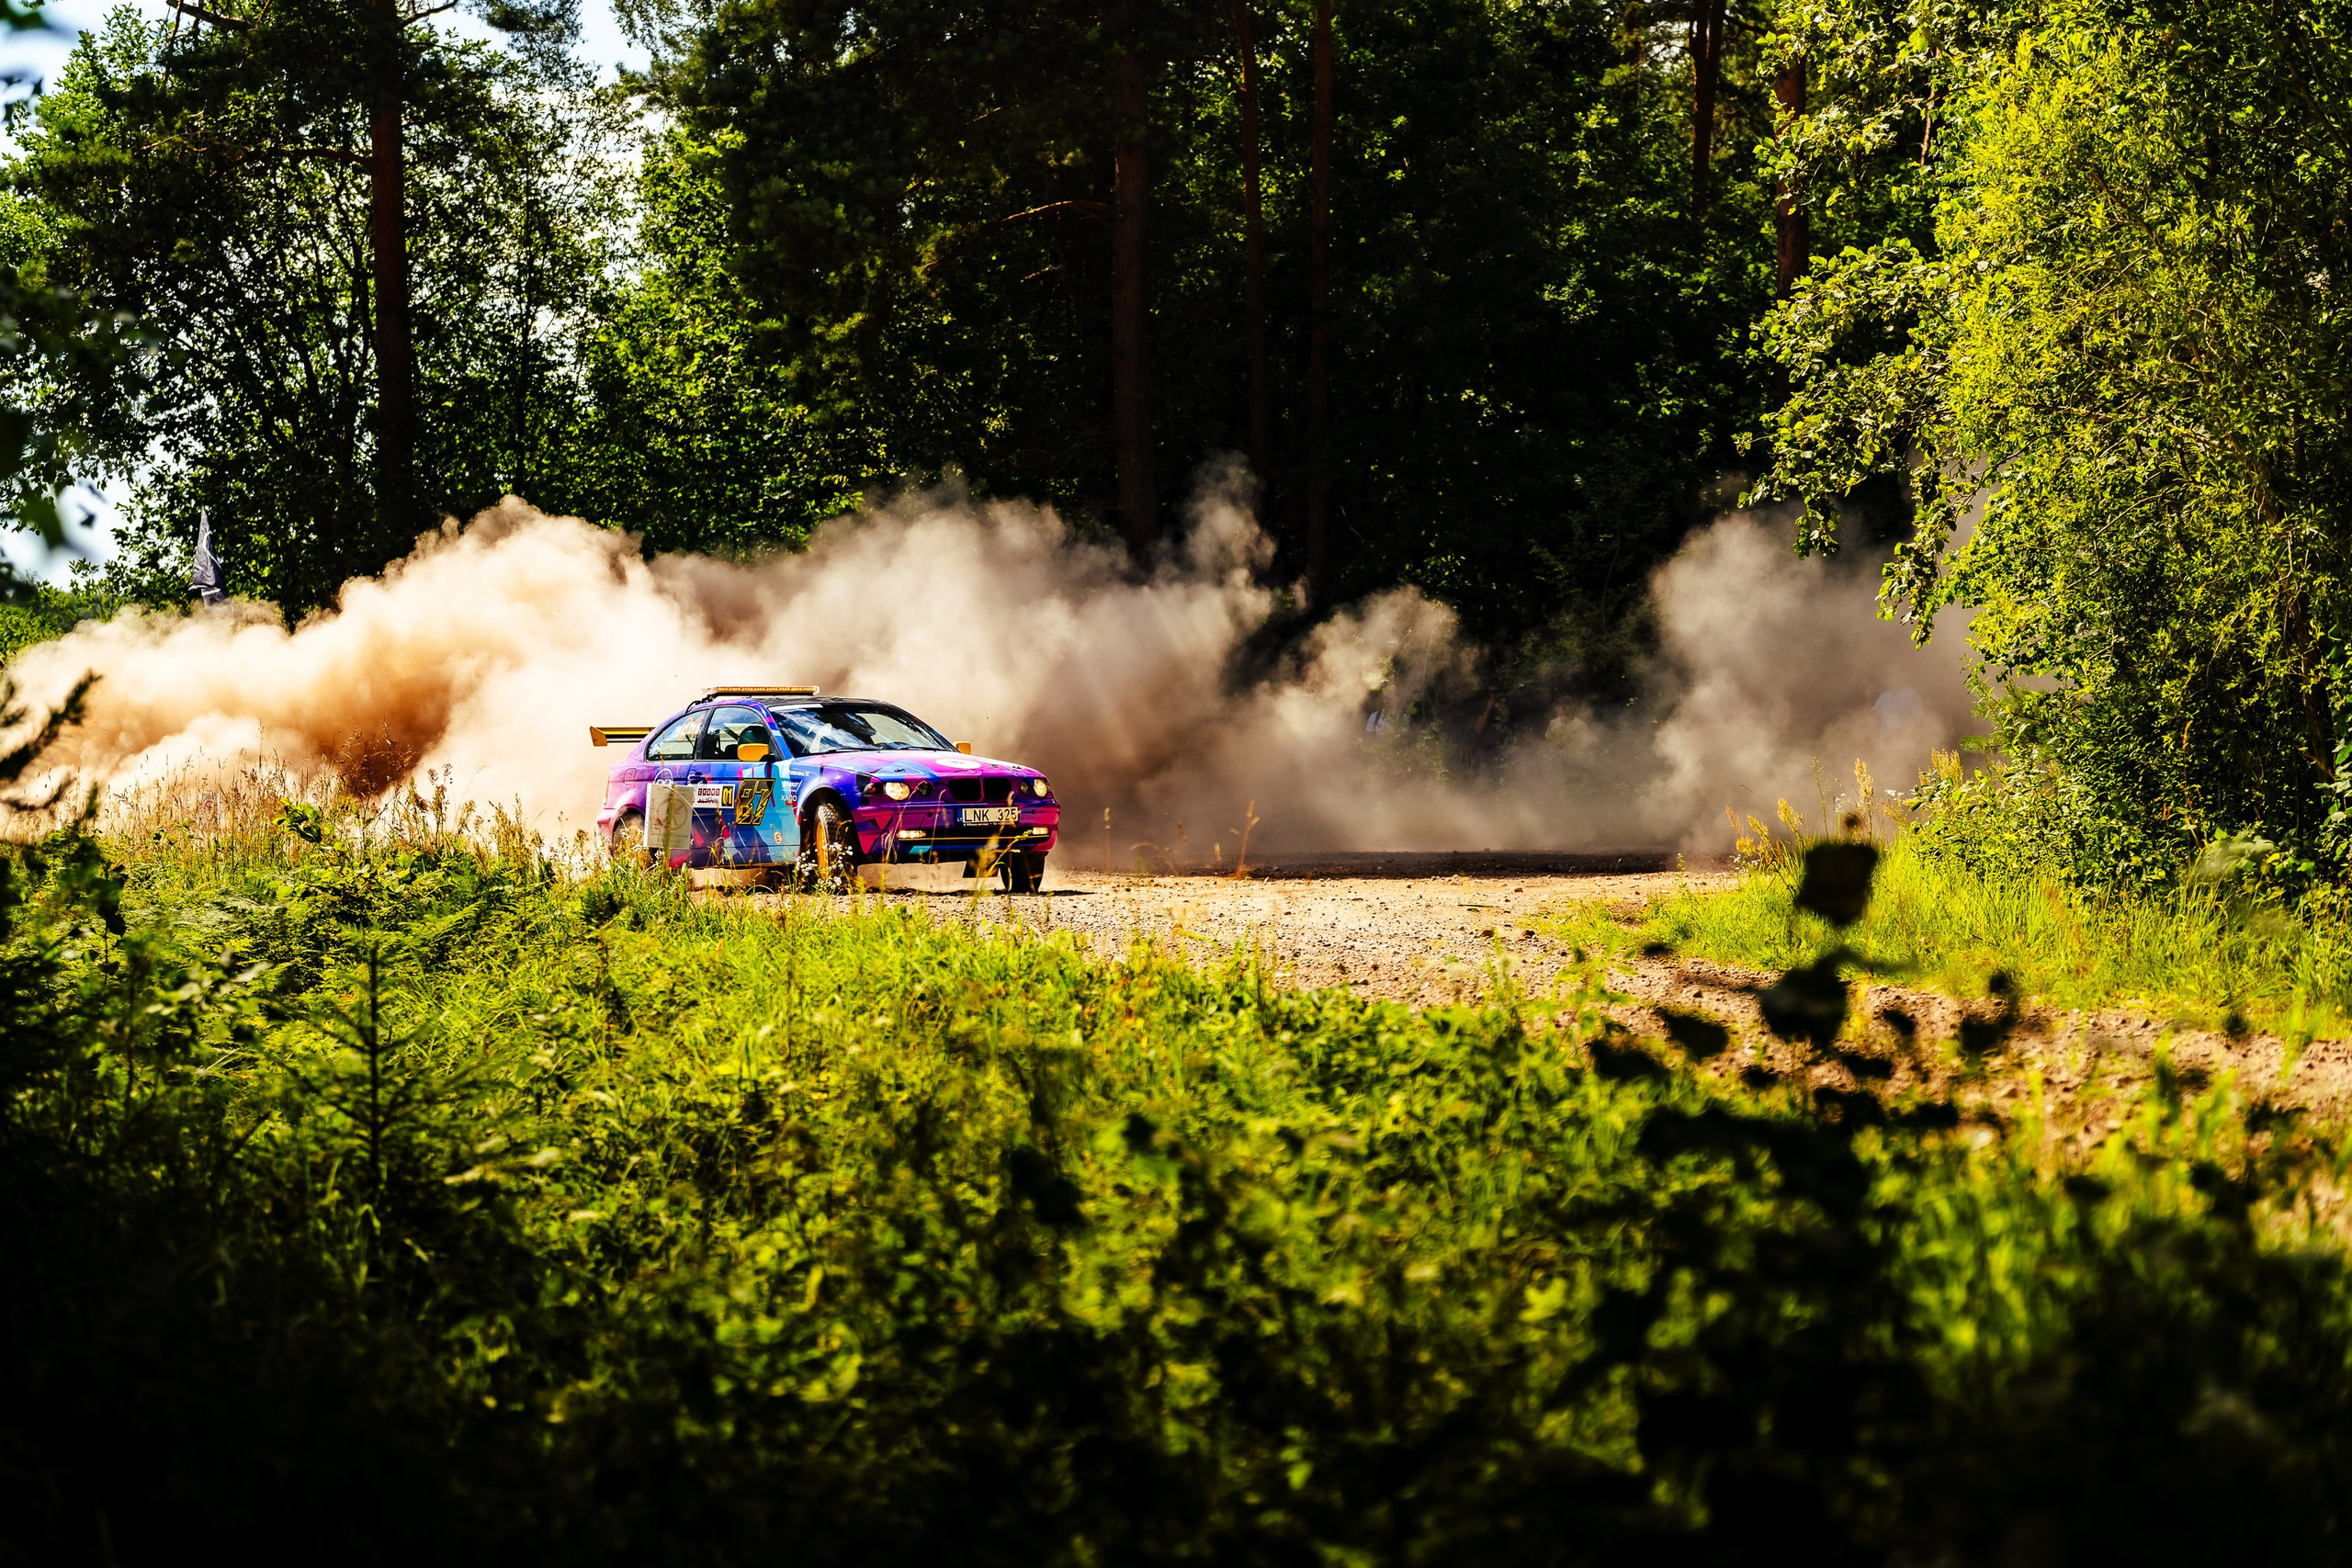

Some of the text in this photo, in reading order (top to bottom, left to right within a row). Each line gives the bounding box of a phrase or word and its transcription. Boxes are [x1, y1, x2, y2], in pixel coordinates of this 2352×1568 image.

[722, 788, 732, 806] 01
[736, 778, 775, 825] 87
[964, 808, 1017, 822] LNK 325
